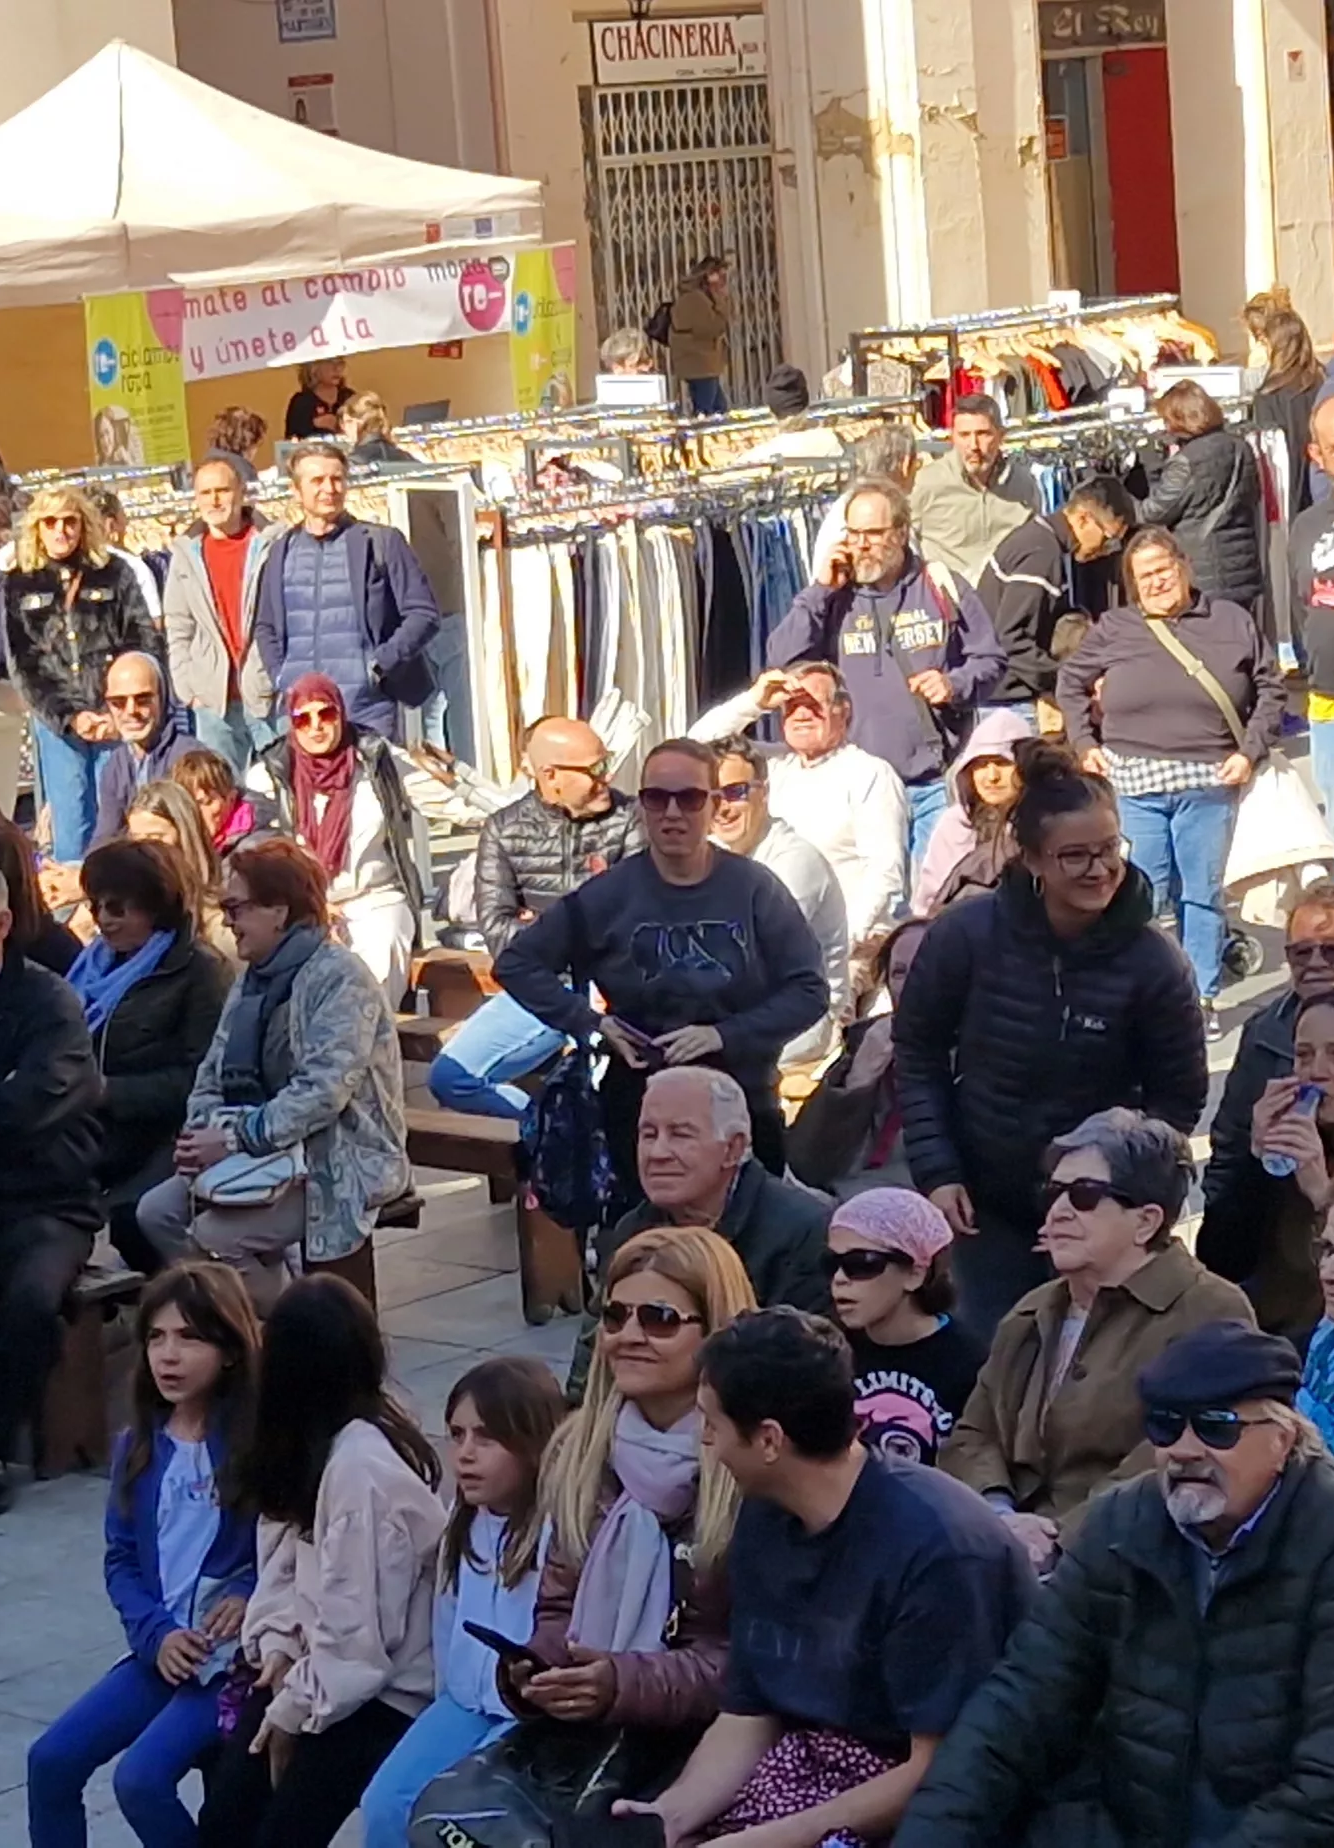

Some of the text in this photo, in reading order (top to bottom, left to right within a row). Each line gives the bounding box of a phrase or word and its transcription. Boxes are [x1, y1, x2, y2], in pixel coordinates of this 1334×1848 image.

[600, 22, 737, 62] CHACINERIA
[262, 279, 291, 307] al
[190, 315, 374, 375] y únete a la
